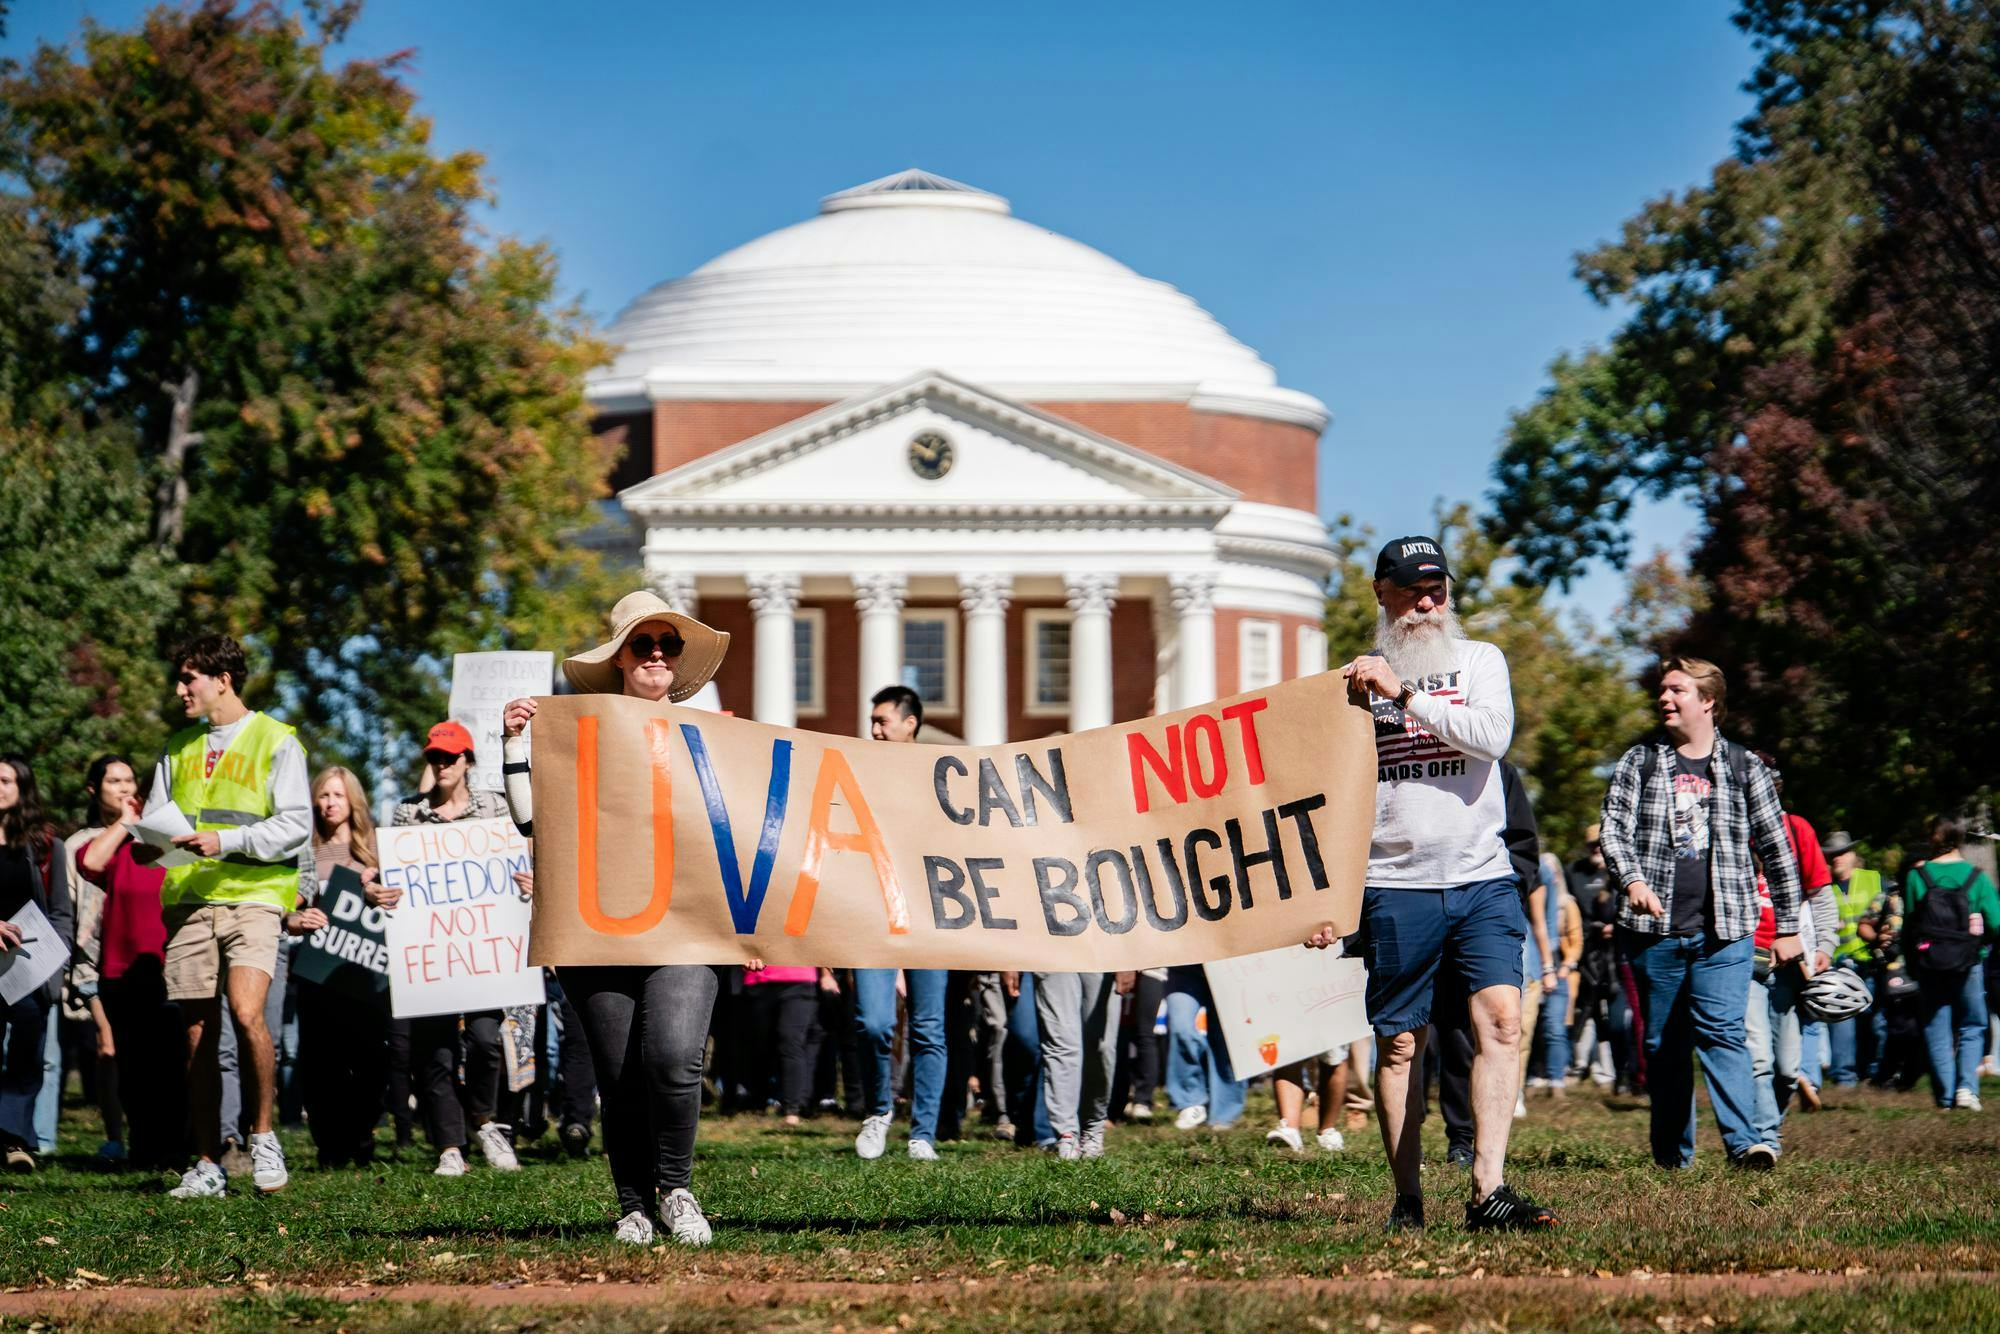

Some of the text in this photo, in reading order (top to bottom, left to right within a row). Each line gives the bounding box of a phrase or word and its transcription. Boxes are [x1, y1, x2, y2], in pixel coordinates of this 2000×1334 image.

[1401, 542, 1438, 558] ANTIFA
[1418, 670, 1461, 692] IST
[933, 697, 1268, 827] CAN NOT
[1377, 759, 1466, 782] ANDS OFF!
[394, 821, 523, 864] CHOOSE
[576, 716, 911, 936] UVA
[384, 854, 529, 907] FREEDOM
[923, 793, 1331, 937] BE BOUGHT
[430, 903, 497, 938] NOT
[309, 924, 390, 976] SURRE
[404, 935, 524, 984] FEALTY
